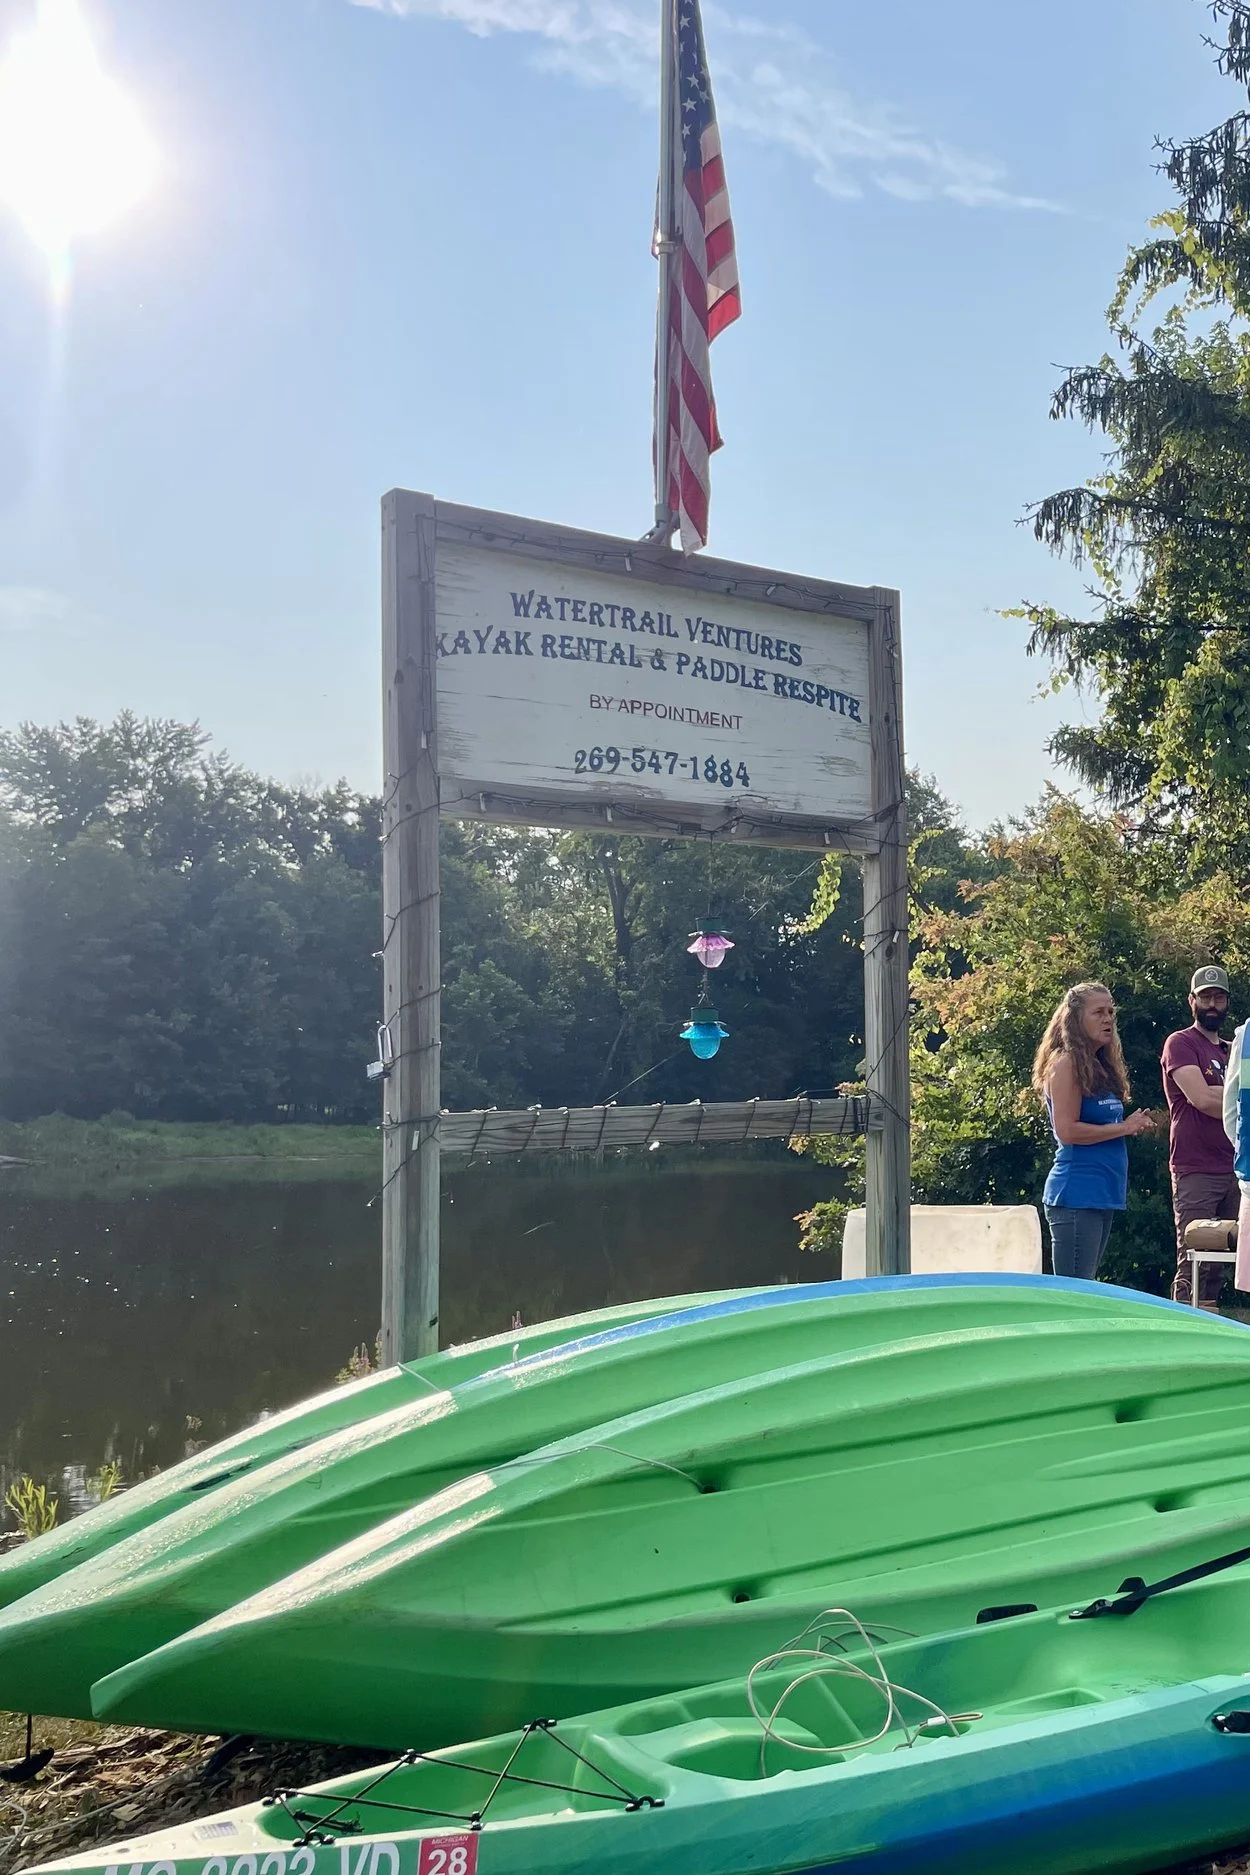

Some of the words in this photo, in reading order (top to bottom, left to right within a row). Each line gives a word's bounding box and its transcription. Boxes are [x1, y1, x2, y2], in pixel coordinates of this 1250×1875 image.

[511, 590, 678, 638] WATERTRAIL
[685, 616, 803, 666] VENTURES
[436, 625, 534, 657] KAYAK
[541, 634, 642, 668] RENTAL
[650, 649, 667, 671] &
[676, 652, 768, 691] PADDLE
[773, 672, 862, 724] RESPITE
[589, 694, 615, 711] BY
[618, 699, 743, 730] APPOINTMENT
[574, 746, 750, 788] 269-547-1884
[431, 1835, 469, 1845] MICHIGAN
[427, 1846, 468, 1875] 28
